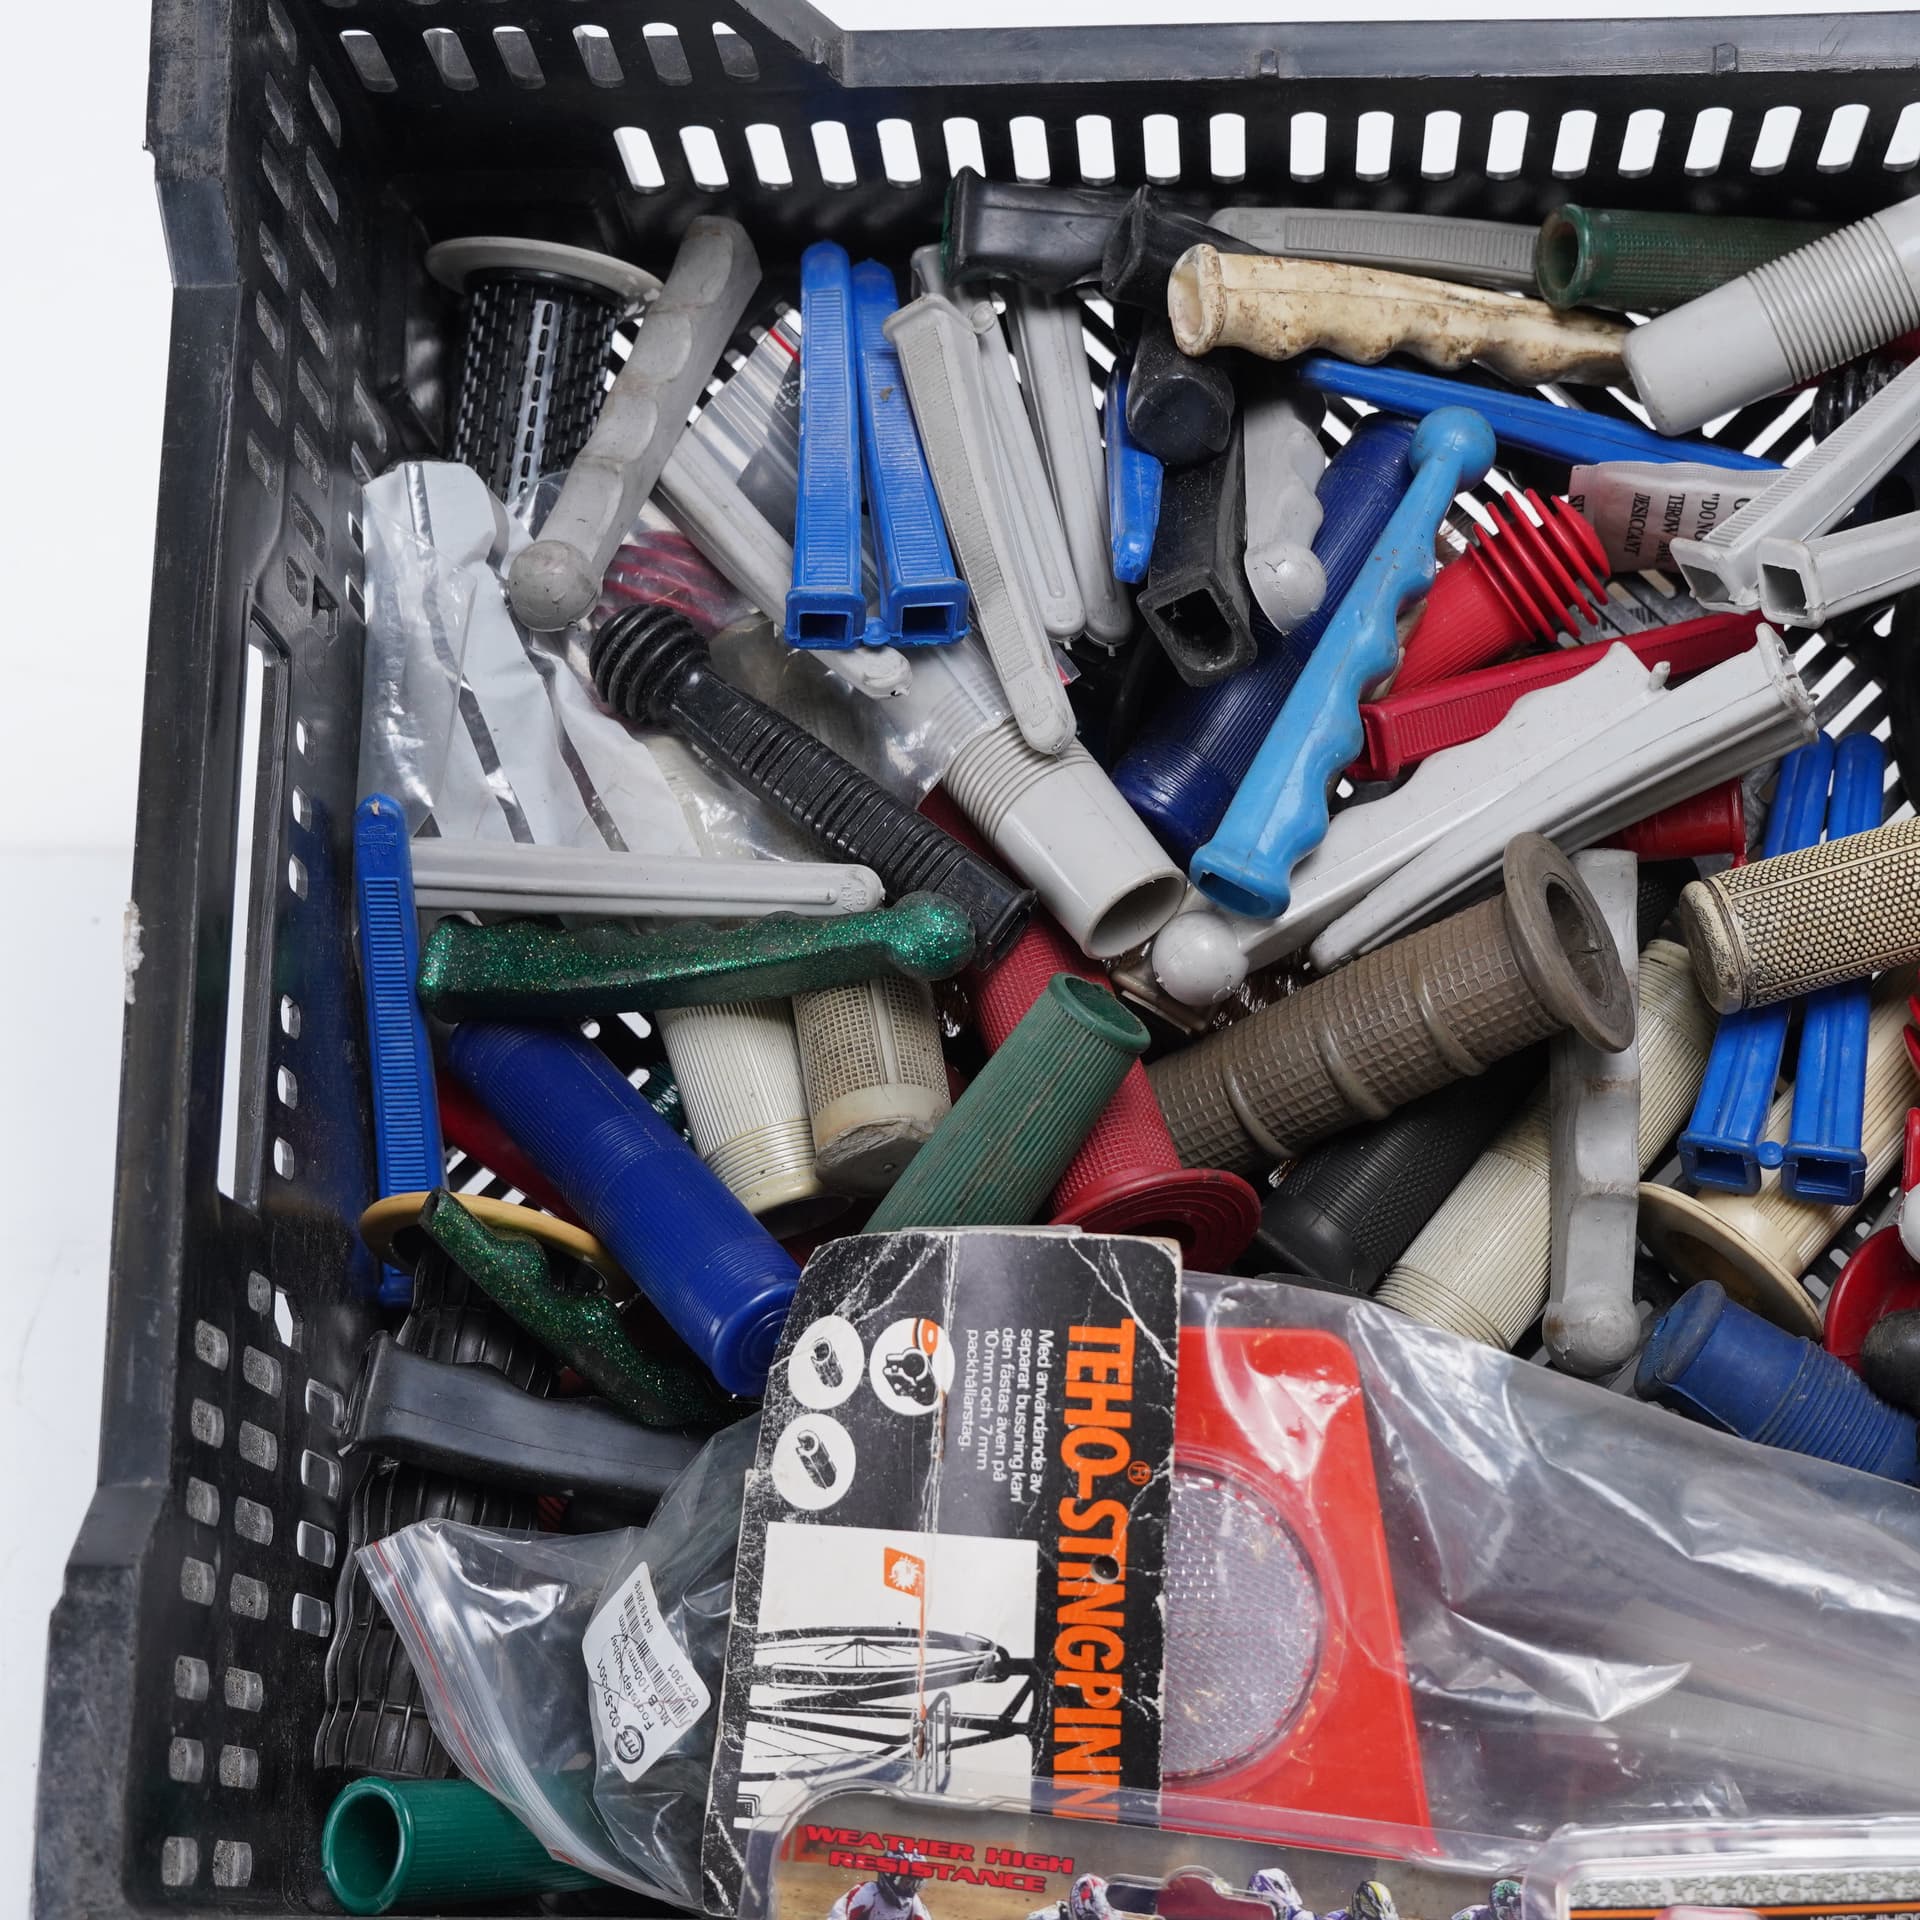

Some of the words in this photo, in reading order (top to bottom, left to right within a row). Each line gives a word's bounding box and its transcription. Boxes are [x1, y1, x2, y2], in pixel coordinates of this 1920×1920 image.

[1624, 492, 1651, 556] DESICCANT
[1661, 493, 1686, 537] THROW
[1001, 1327, 1017, 1359] den
[1016, 1328, 1033, 1390] separat
[1036, 1329, 1055, 1369] Med
[957, 1329, 980, 1453] packhållarstag.
[980, 1387, 995, 1420] och
[997, 1361, 1016, 1413] fästas
[995, 1415, 1011, 1456] även
[1008, 1394, 1032, 1470] bussning
[1030, 1370, 1051, 1471] användande
[992, 1459, 1008, 1483] på
[1010, 1472, 1026, 1502] kan
[1029, 1473, 1042, 1495] av
[647, 1693, 672, 1727] MCB
[805, 1824, 975, 1861] WEATHER
[985, 1846, 1074, 1875] HIGH
[829, 1850, 1048, 1894] RESISTANCE
